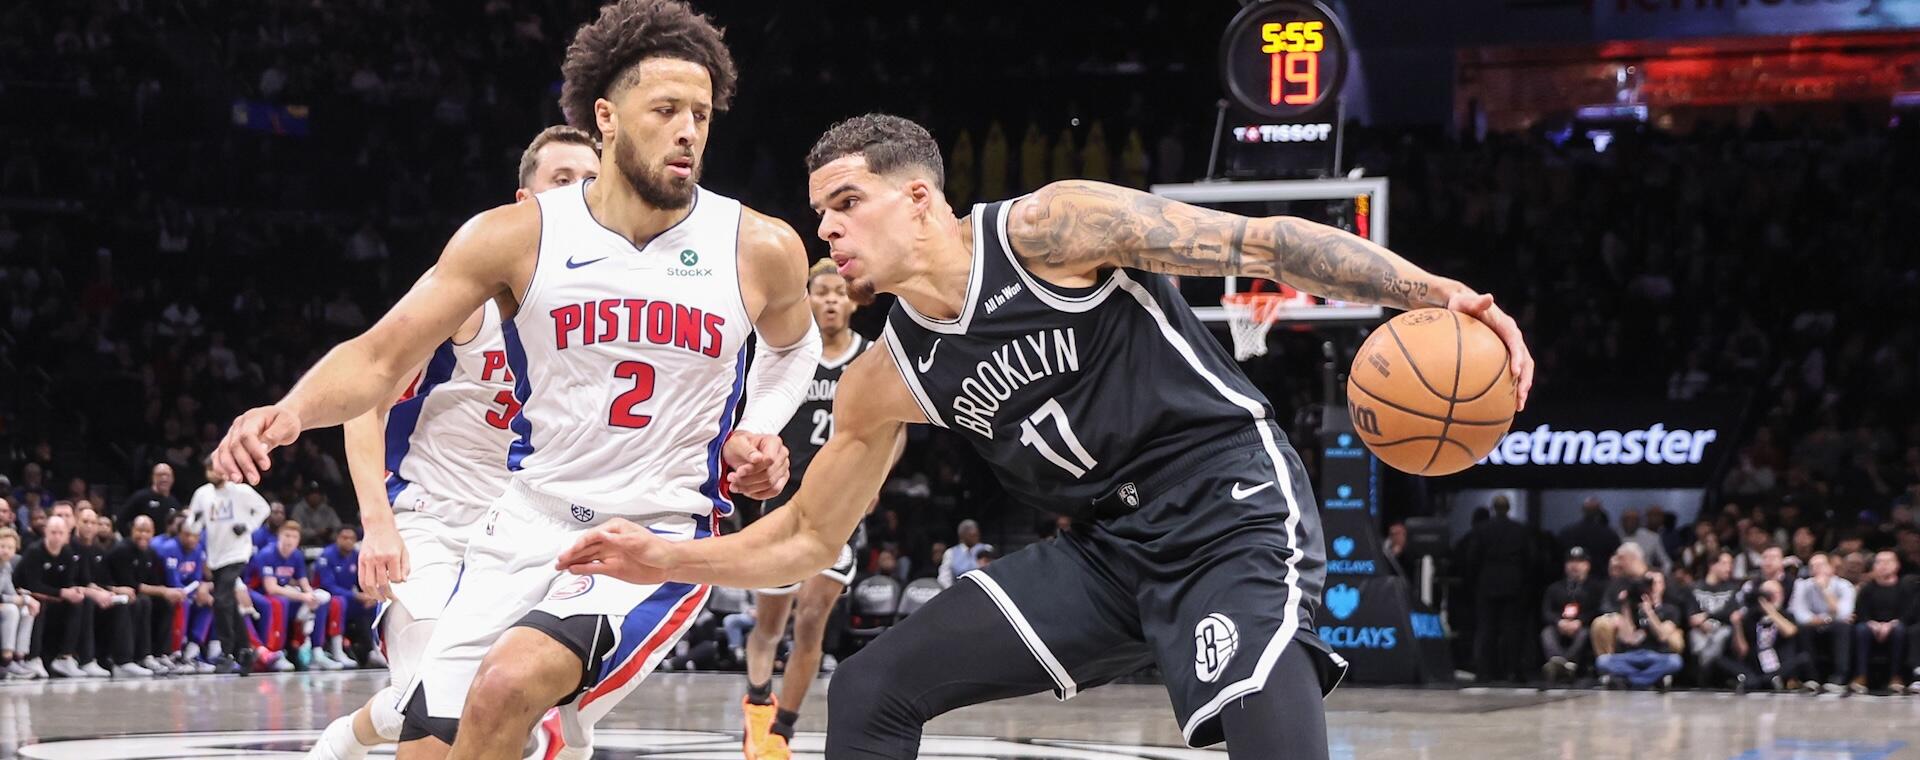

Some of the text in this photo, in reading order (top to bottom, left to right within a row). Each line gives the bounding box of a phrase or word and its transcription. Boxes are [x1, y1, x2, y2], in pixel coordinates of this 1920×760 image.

[1261, 21, 1324, 53] 5:55
[1270, 52, 1318, 105] 19
[1259, 124, 1332, 142] TISSOT
[666, 267, 713, 277] StockX
[984, 282, 1023, 315] All In Won
[550, 299, 726, 359] PISTONS
[607, 360, 656, 429] 2
[952, 327, 1080, 440] BROOKLYN
[1018, 397, 1098, 479] 17
[1478, 422, 1718, 466] etmaster
[1327, 559, 1376, 575] RCLAYS
[1318, 625, 1398, 650] RCLAYS
